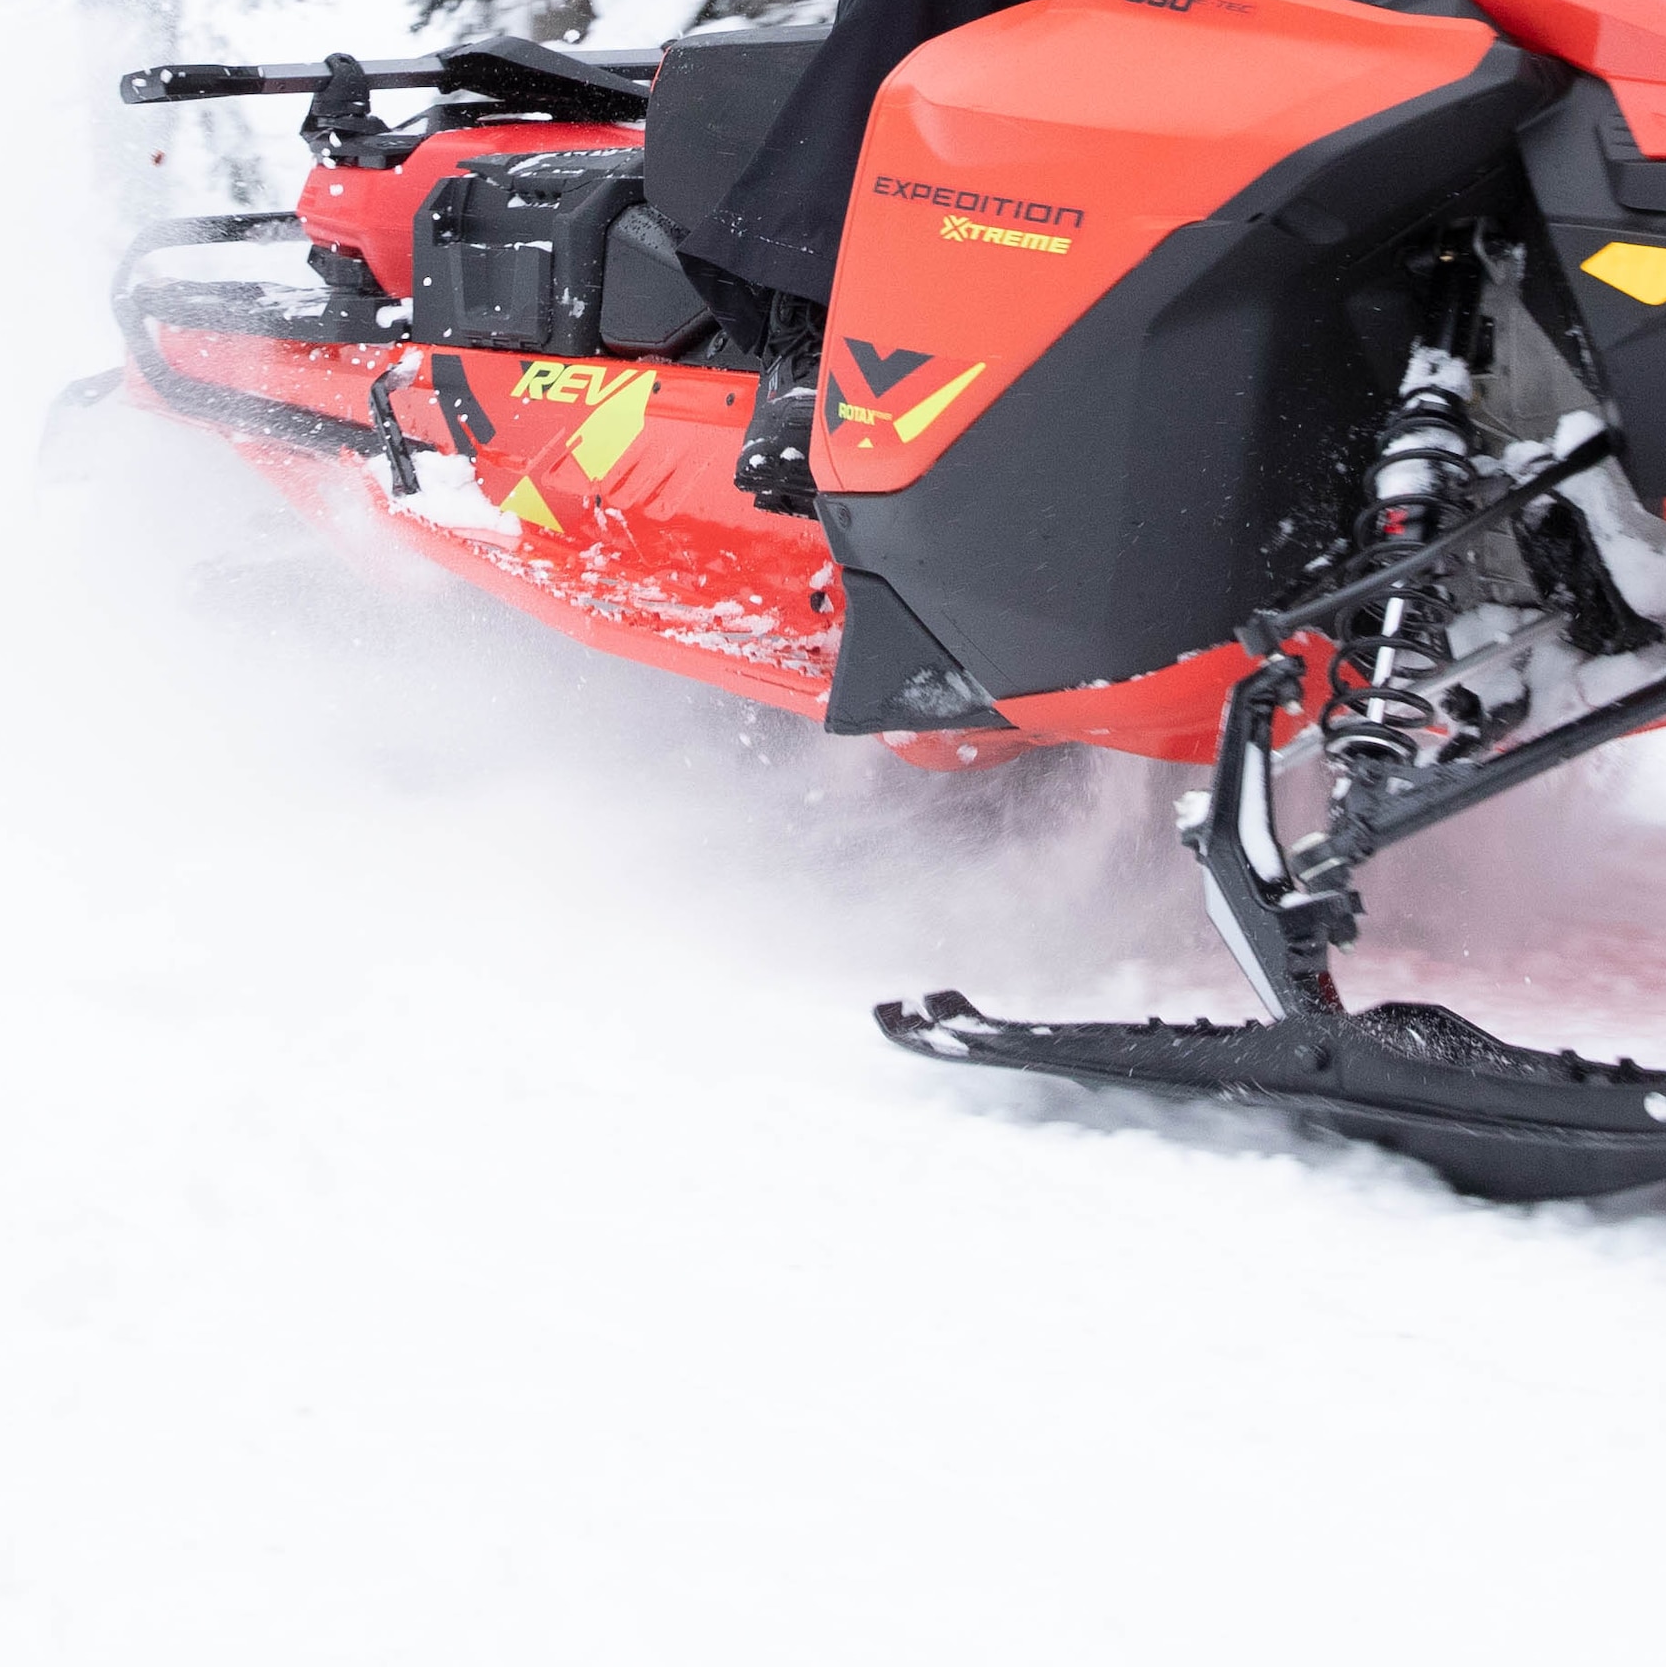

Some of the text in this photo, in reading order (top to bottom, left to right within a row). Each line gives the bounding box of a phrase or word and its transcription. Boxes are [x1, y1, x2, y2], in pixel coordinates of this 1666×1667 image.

[872, 176, 1085, 229] EXPEDITION
[940, 214, 1073, 255] XTREME
[510, 360, 639, 406] REV
